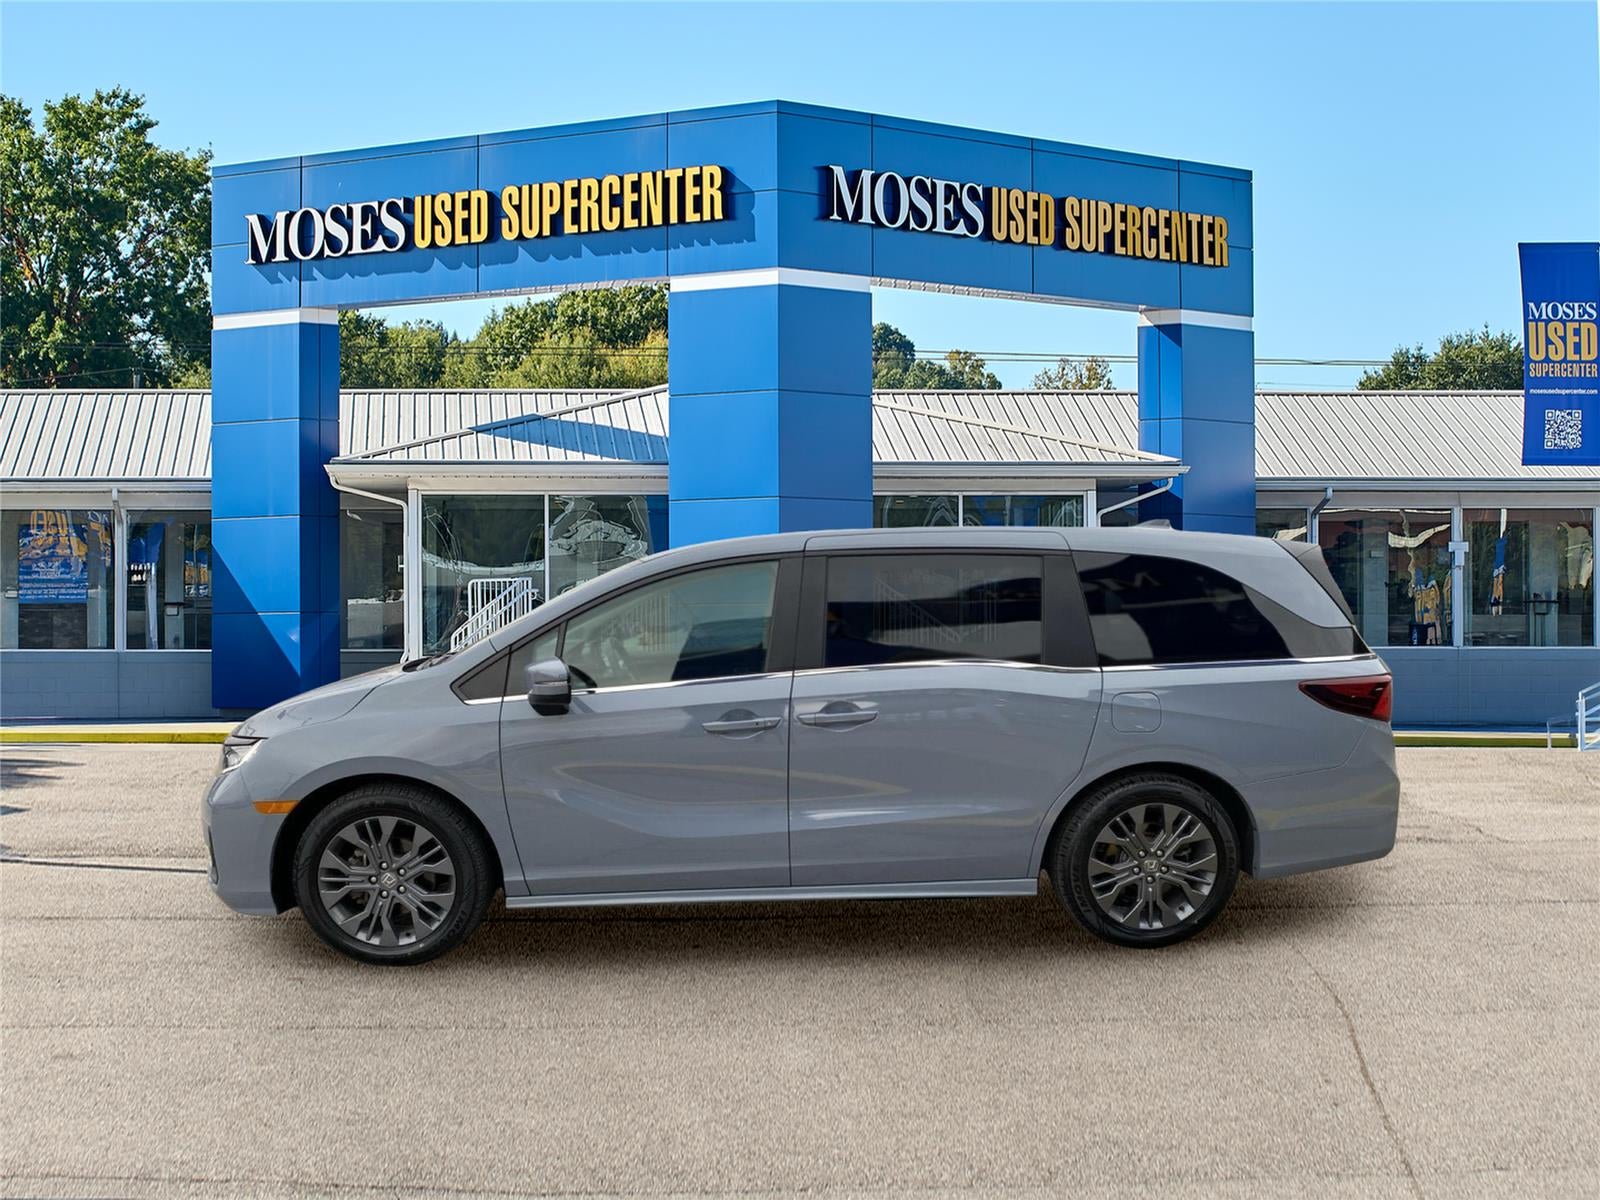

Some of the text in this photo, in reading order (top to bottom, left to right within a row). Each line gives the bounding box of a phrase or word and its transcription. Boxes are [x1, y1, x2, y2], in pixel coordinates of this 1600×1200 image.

[245, 164, 724, 265] MOSES USED SUPERCENTER
[828, 164, 1230, 268] MOSES USED SUPERCENTER
[1527, 301, 1597, 320] MOSES
[1528, 321, 1598, 361] USED
[1528, 363, 1598, 378] SUPERCENTER
